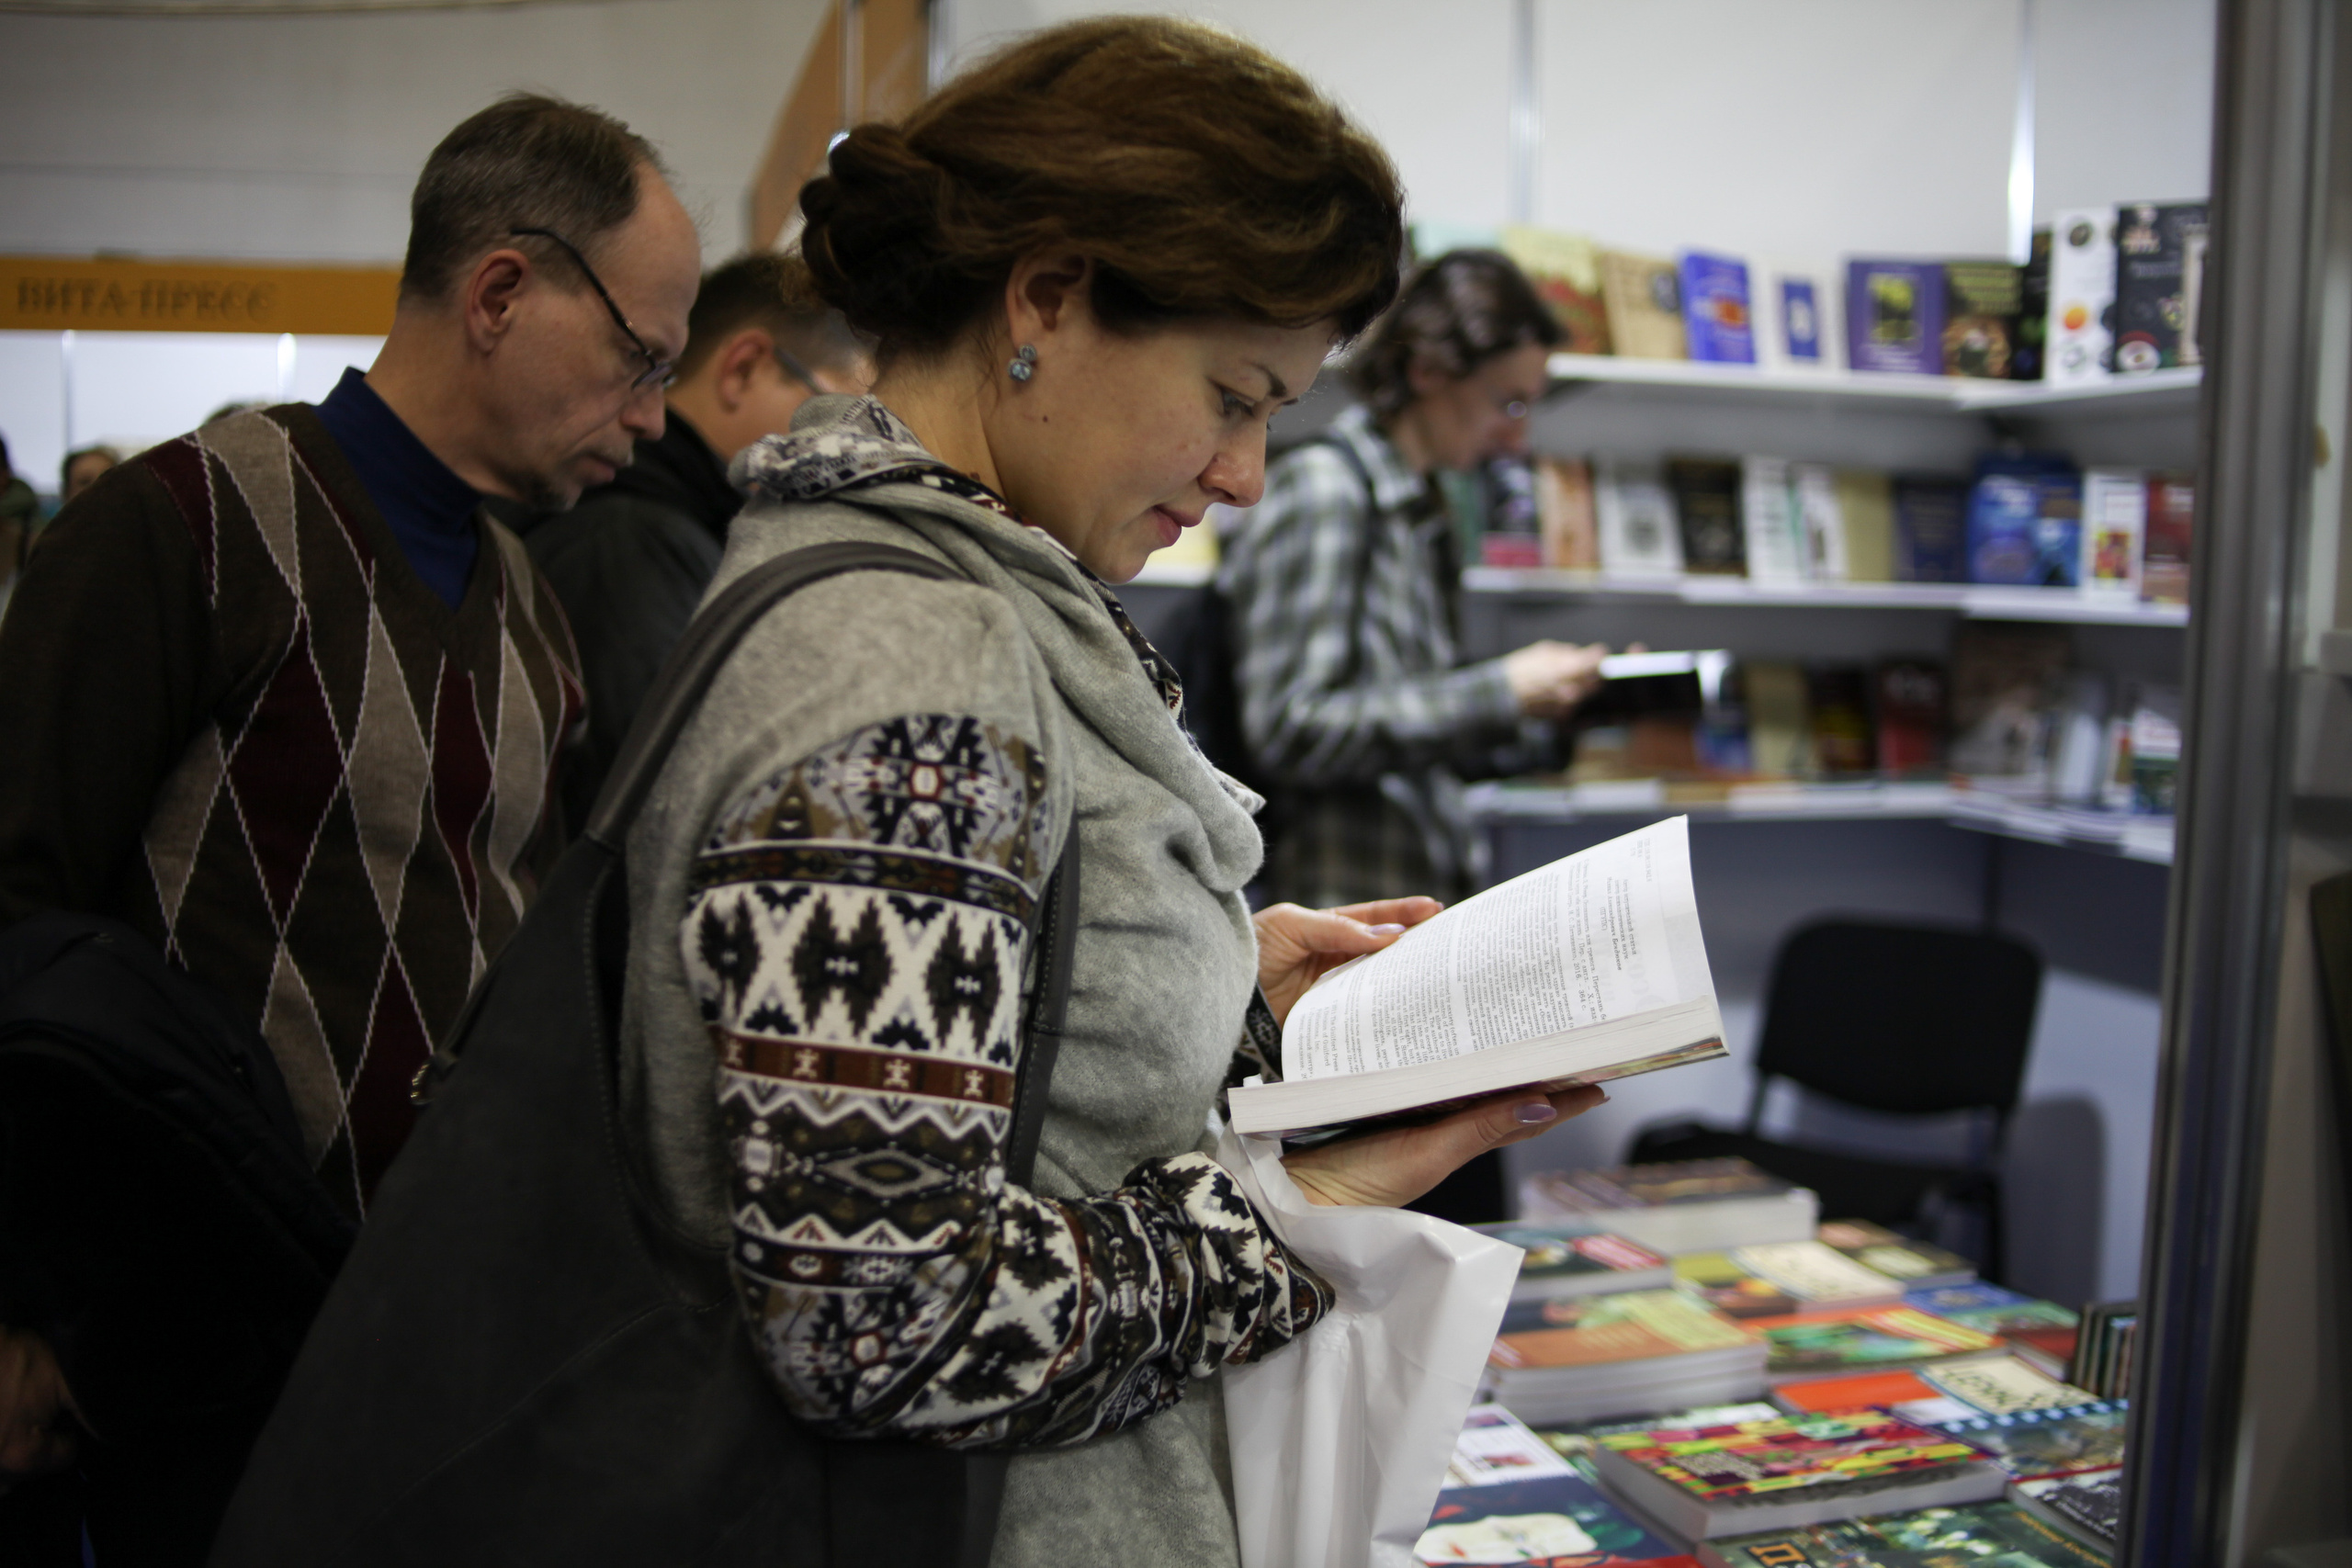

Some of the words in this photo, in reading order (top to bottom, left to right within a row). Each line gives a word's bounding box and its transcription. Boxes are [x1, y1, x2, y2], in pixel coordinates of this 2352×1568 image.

[1511, 971, 1520, 997] другими
[1586, 947, 1594, 974] тревога.
[1590, 975, 1603, 1012] Перестань
[1515, 998, 1525, 1027] словами,
[1530, 962, 1539, 986] Авторы
[1539, 1008, 1549, 1035] «Осозна
[1552, 976, 1560, 998] здраво
[1557, 999, 1566, 1028] мыслить
[1561, 992, 1572, 1021] тревогой
[1419, 1001, 1428, 1026] anxiety:
[1424, 1033, 1433, 1054] accept
[1445, 1003, 1454, 1026] anxiety
[1486, 1005, 1497, 1047] незаменимы
[1498, 1007, 1506, 1032] служат
[1530, 998, 1540, 1034] отношения
[1393, 1037, 1401, 1057] makes
[1409, 1024, 1419, 1050] happens
[1430, 1029, 1440, 1053] authors
[1444, 1028, 1453, 1056] emotions
[1449, 1026, 1458, 1045] (often
[1399, 1043, 1409, 1066] Simple
